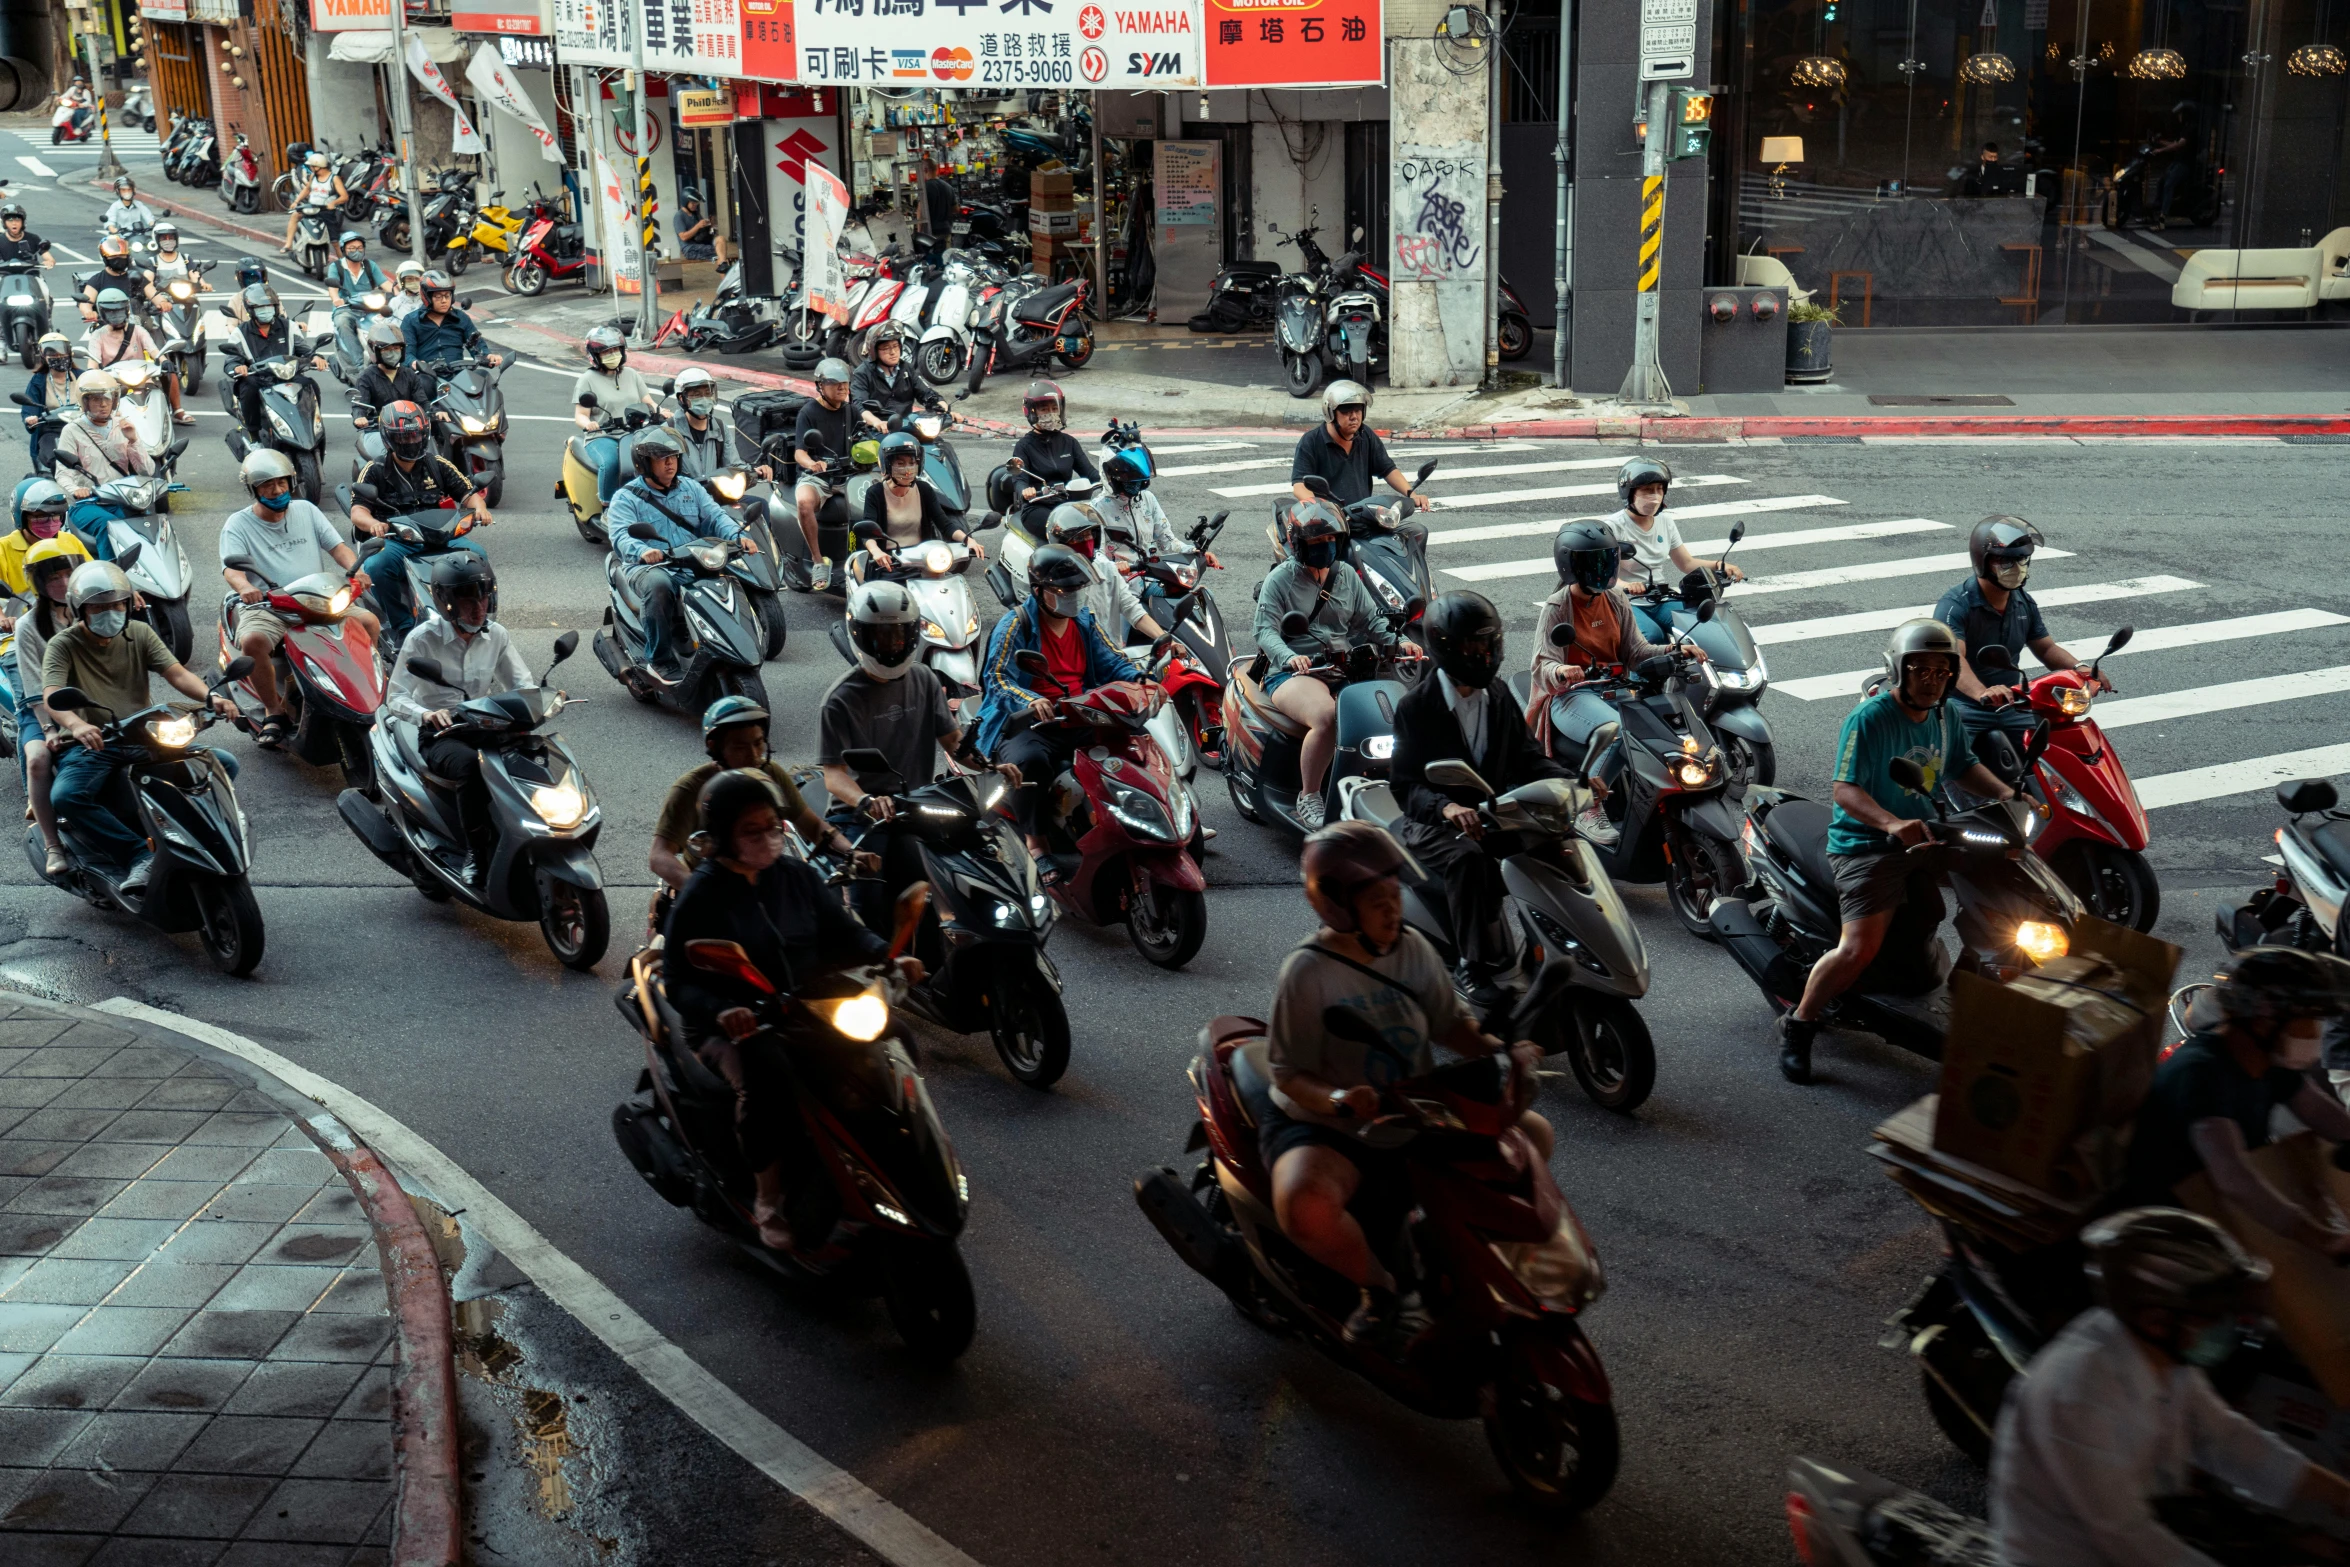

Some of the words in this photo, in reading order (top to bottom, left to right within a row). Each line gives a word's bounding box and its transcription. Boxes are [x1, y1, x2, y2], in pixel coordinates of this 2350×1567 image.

[745, 20, 792, 43] 摩塔石油
[1115, 10, 1191, 34] YAMAHA
[1219, 15, 1366, 45] 摩塔石油
[980, 33, 1071, 58] 道路救援
[805, 46, 888, 80] 可刷卡
[897, 57, 921, 69] VISA
[932, 58, 975, 70] MasterCard
[982, 60, 1073, 83] 2375-9060
[1126, 52, 1181, 77] SYM
[1685, 96, 1705, 121] 35
